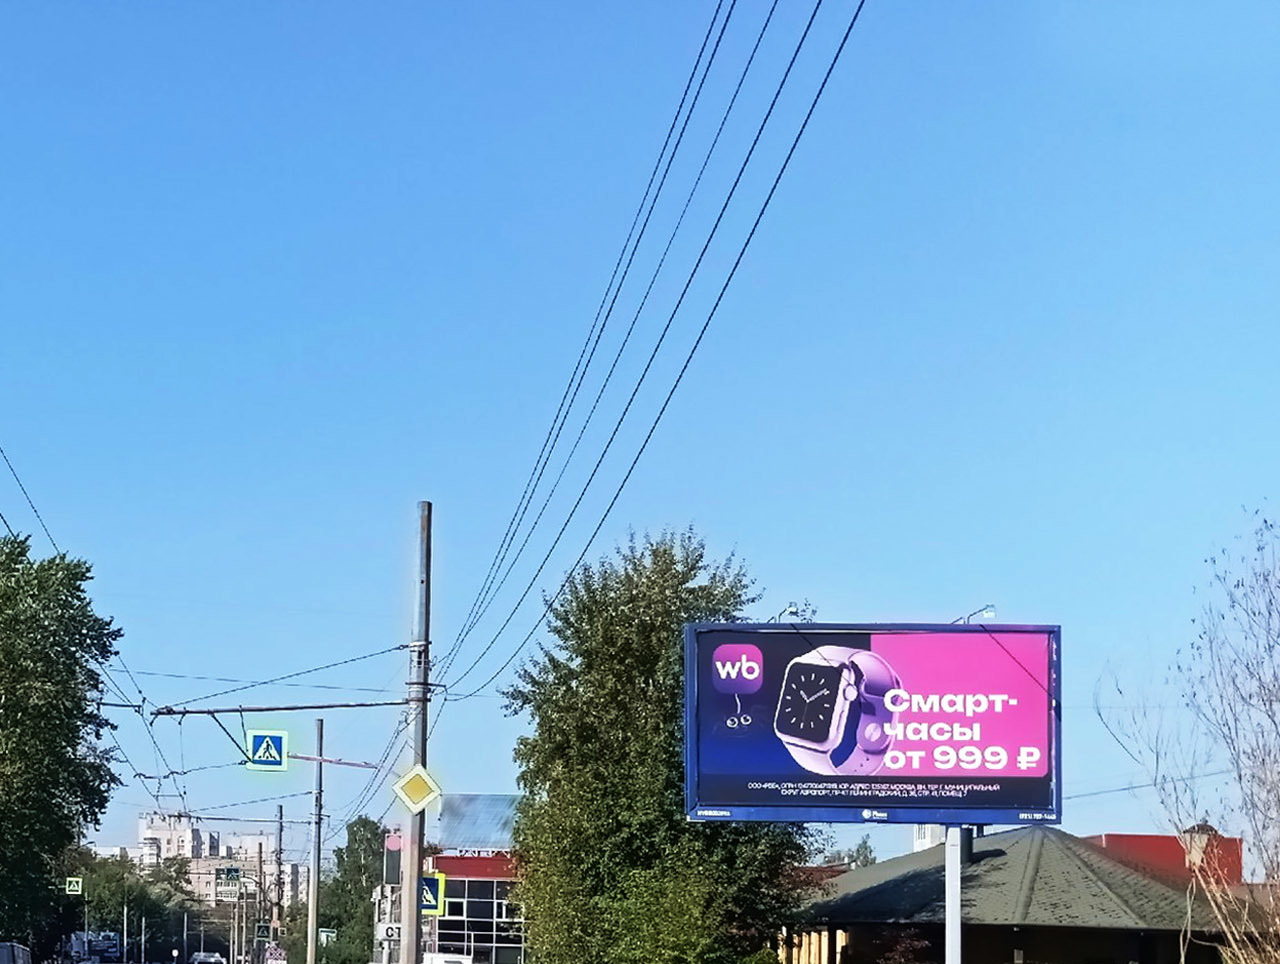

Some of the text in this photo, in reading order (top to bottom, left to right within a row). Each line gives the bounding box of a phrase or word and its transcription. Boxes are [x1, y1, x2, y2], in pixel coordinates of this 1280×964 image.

[715, 654, 760, 680] wb
[883, 688, 1018, 717] Смарт-
[883, 722, 981, 741] часы
[883, 750, 926, 769] от
[932, 745, 1008, 770] 999
